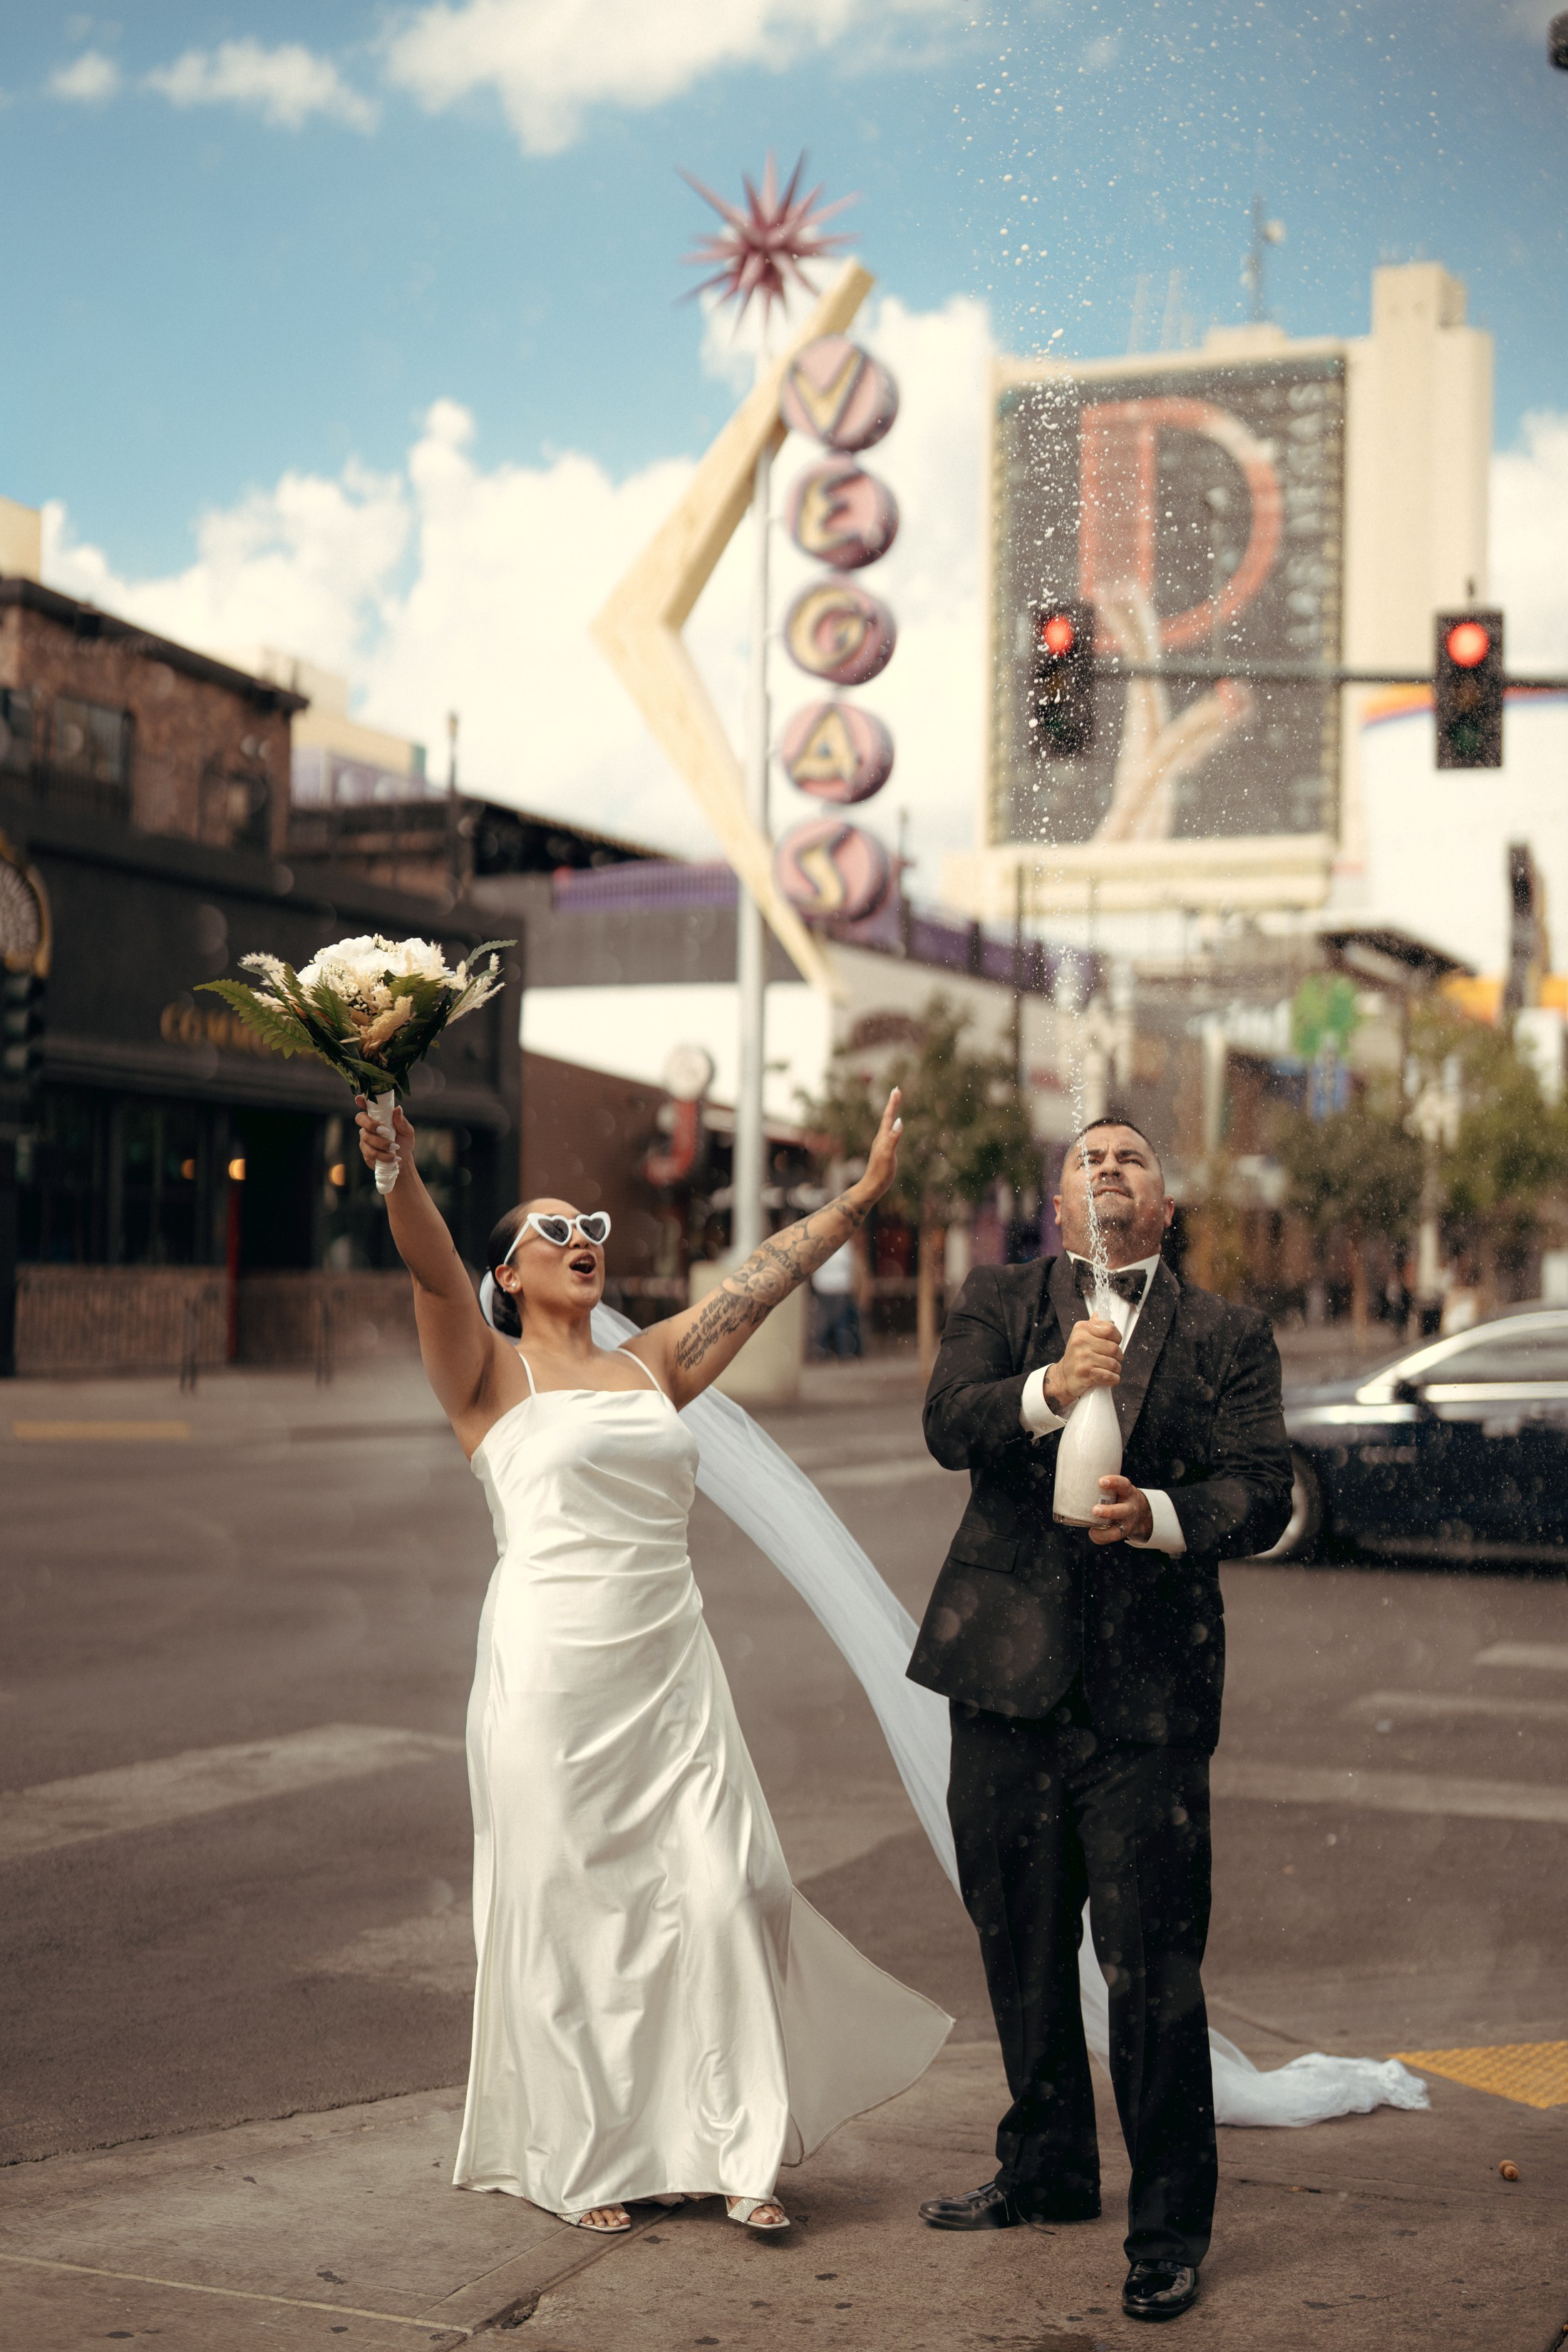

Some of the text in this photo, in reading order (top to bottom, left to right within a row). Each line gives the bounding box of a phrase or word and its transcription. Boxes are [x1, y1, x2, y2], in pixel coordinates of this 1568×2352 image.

[786, 348, 865, 914] VEGAS
[1078, 396, 1281, 654] D
[680, 1331, 692, 1349] can
[691, 1322, 699, 1334] do
[699, 1306, 708, 1324] all
